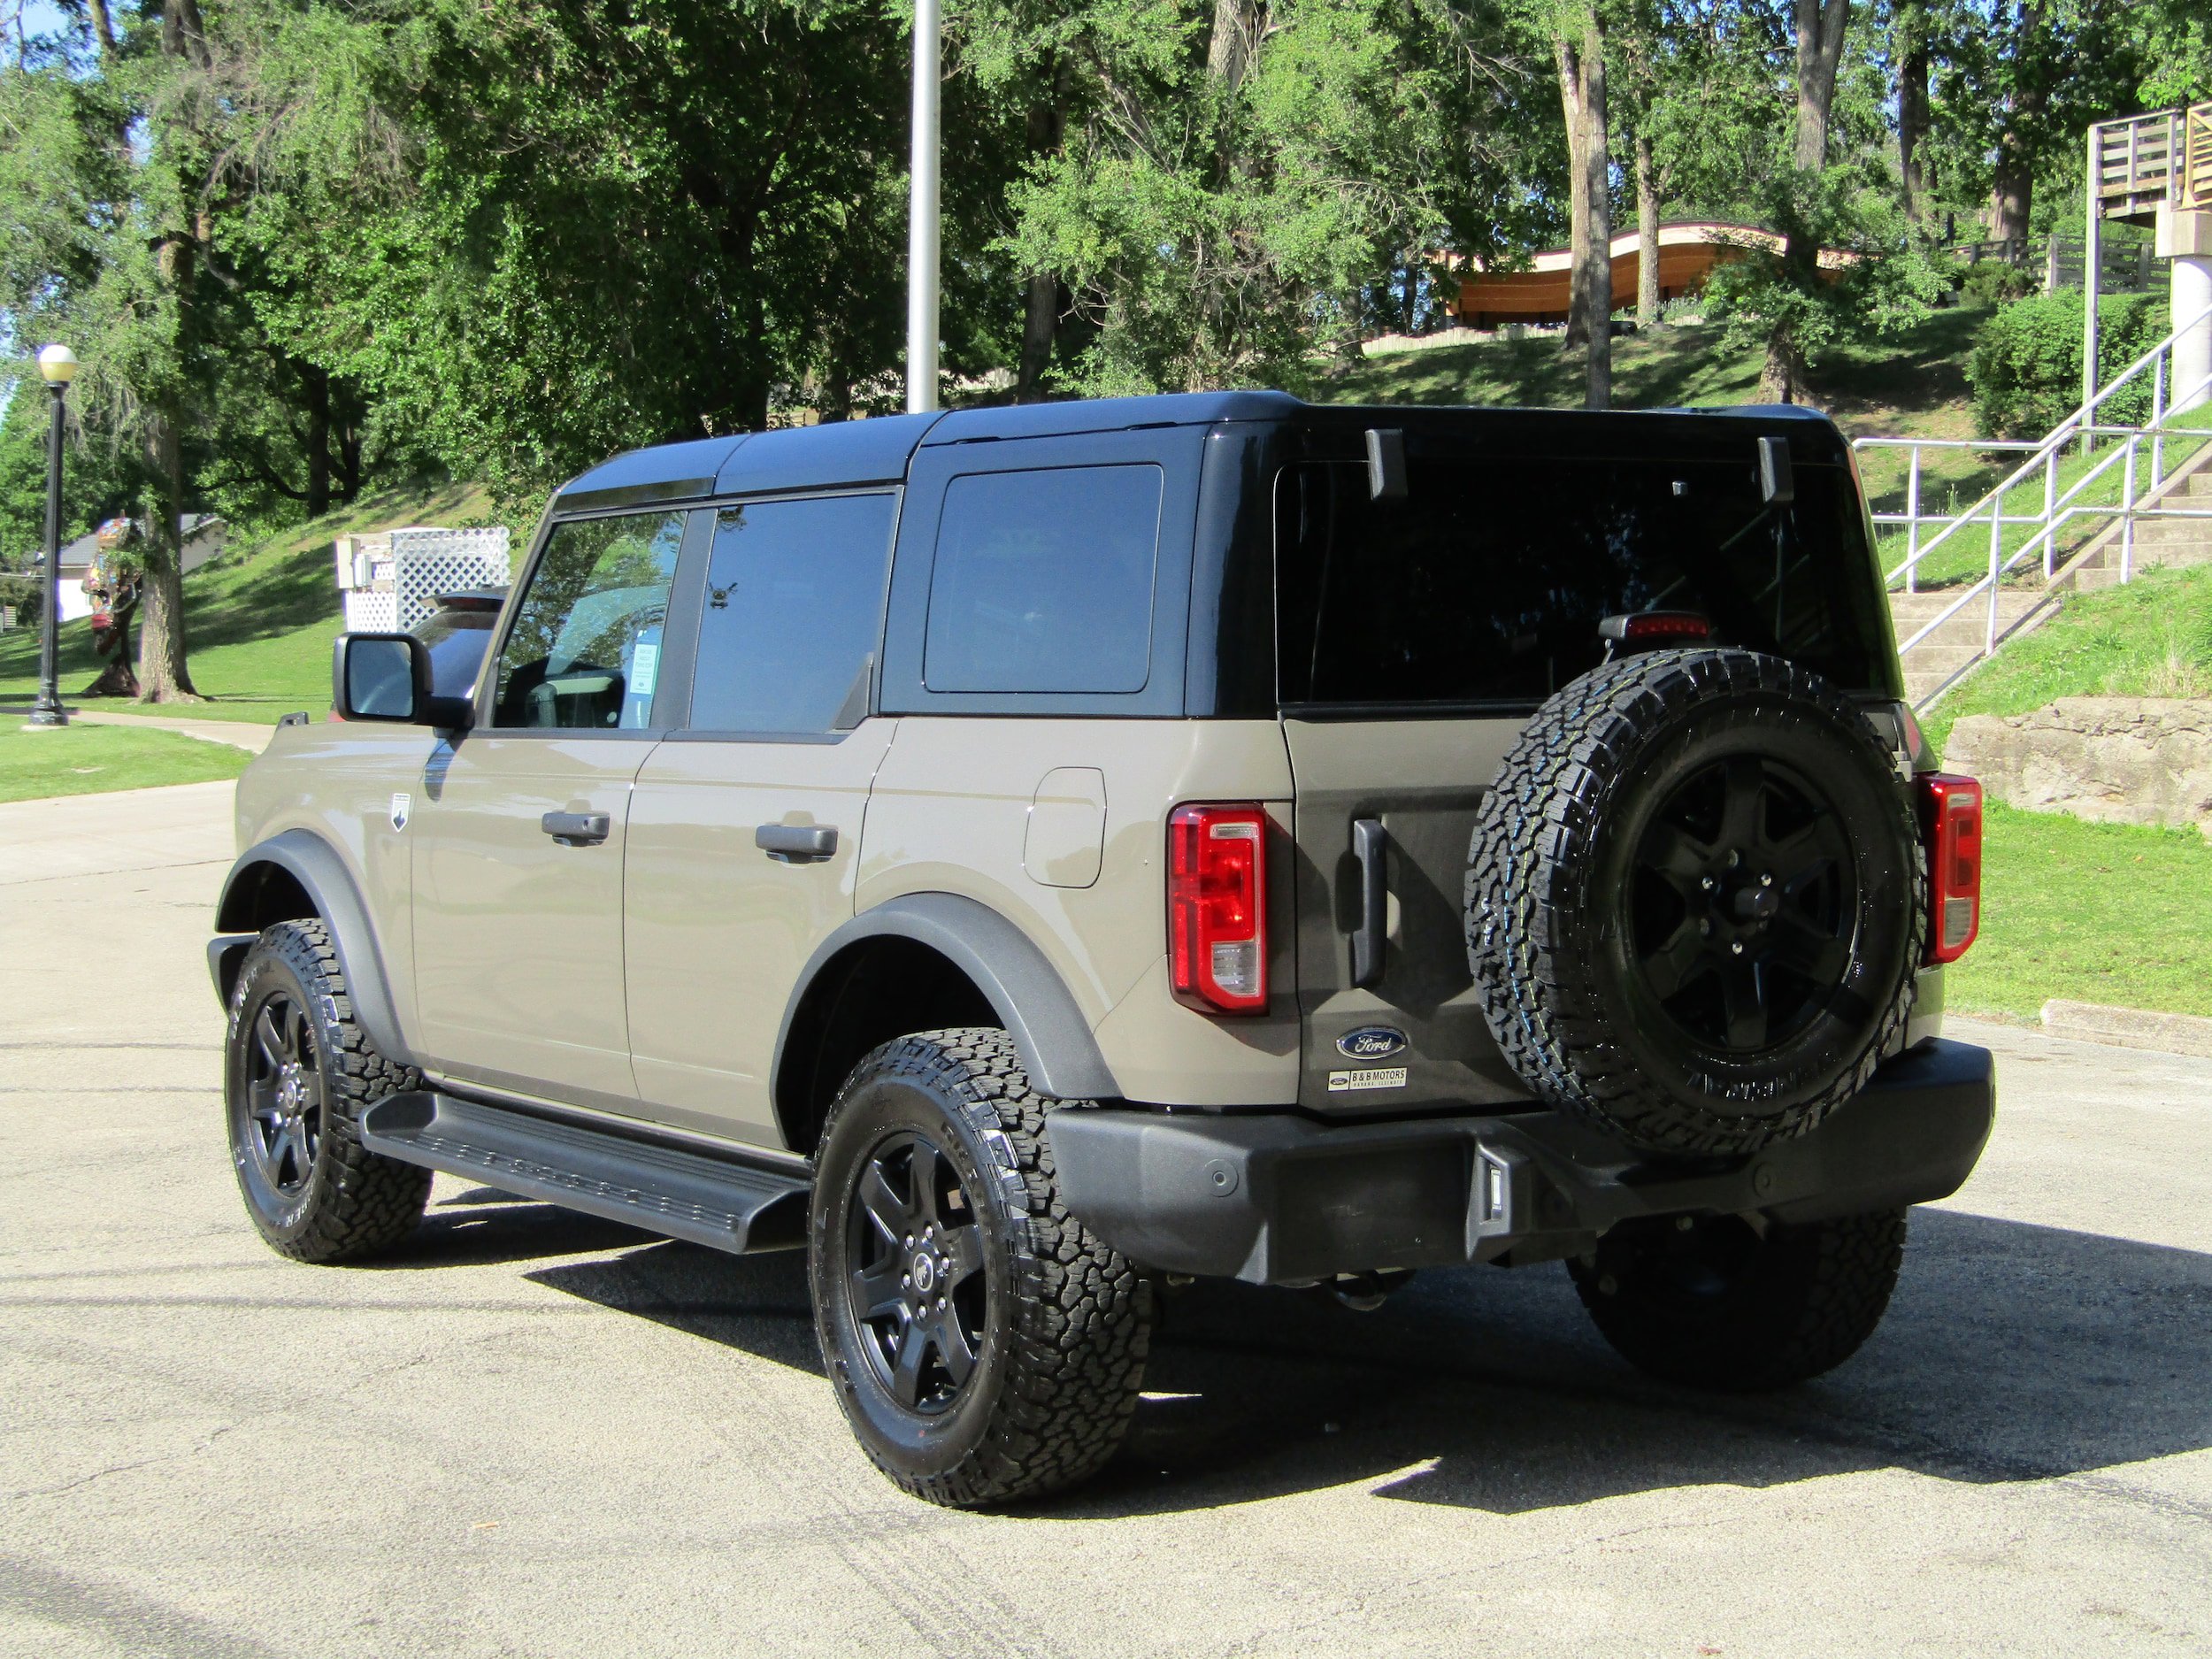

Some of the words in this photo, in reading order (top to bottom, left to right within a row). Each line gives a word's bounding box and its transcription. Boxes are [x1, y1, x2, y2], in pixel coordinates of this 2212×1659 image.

[1355, 1033, 1393, 1053] Ford
[1353, 1072, 1357, 1081] B
[1359, 1072, 1364, 1081] &
[1367, 1071, 1371, 1080] B
[1372, 1070, 1404, 1079] MOTORS
